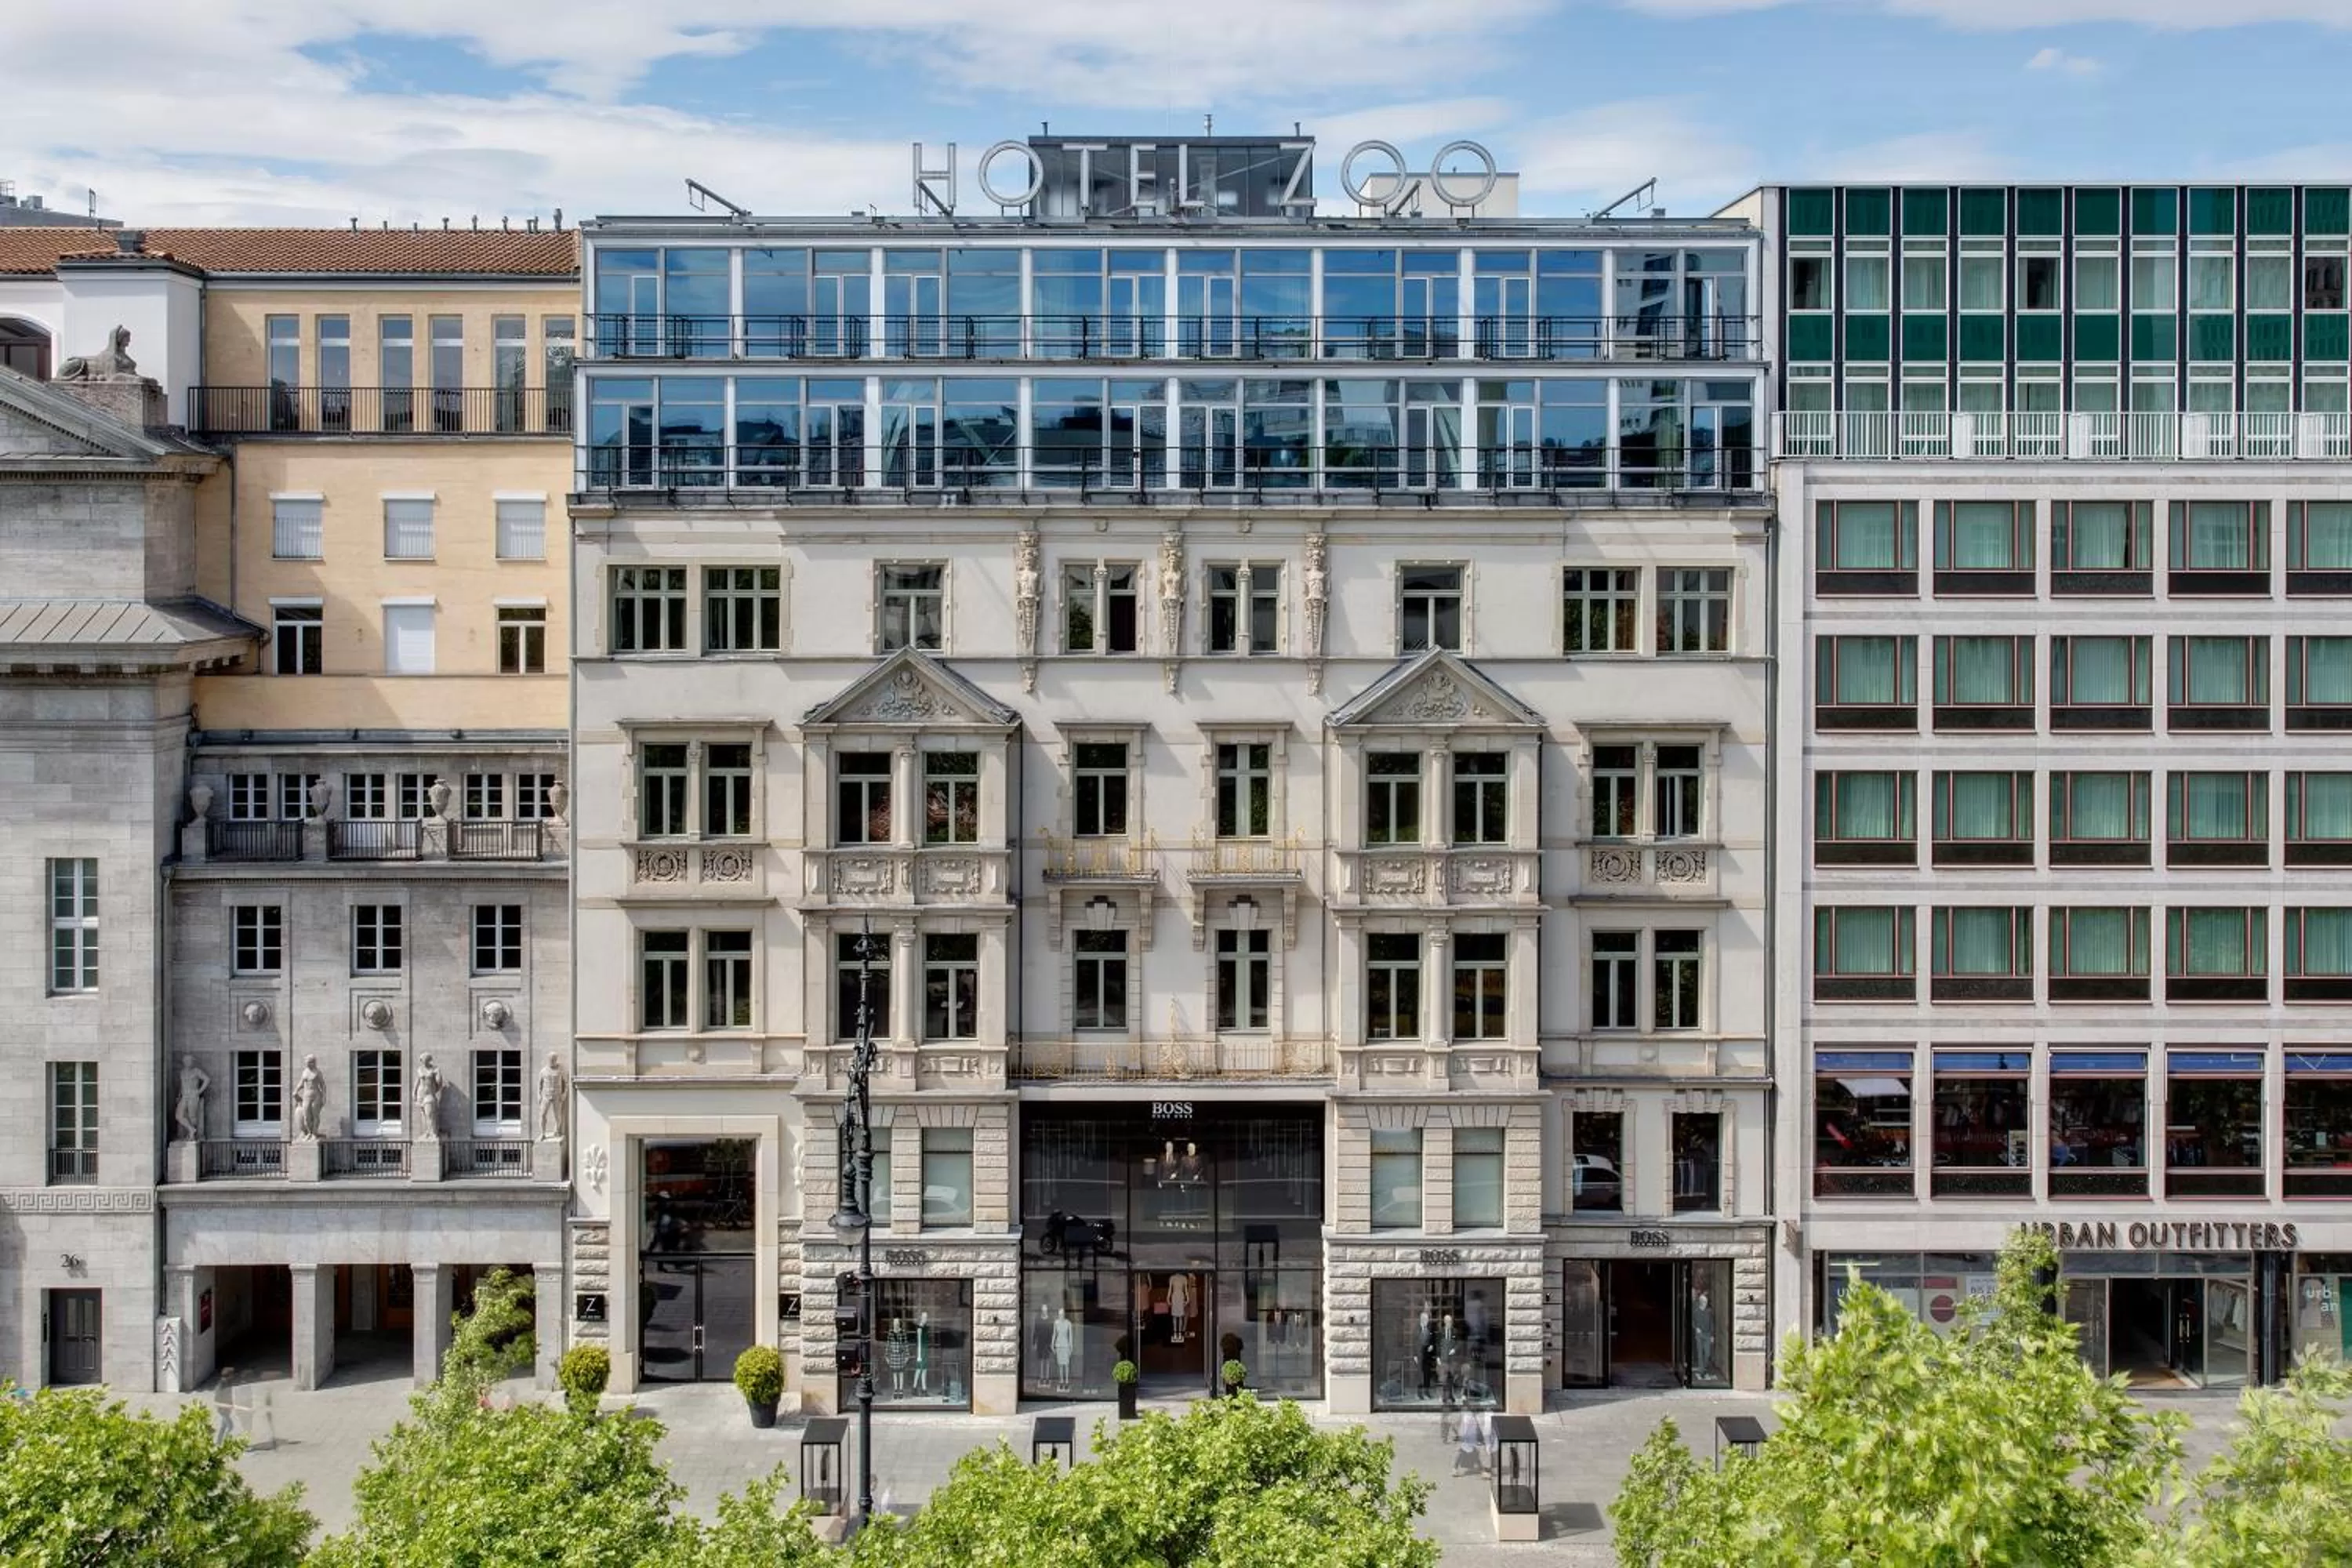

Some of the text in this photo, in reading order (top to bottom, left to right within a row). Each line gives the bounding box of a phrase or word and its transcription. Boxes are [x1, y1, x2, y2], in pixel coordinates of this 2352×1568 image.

[913, 140, 1497, 208] HOTEL ZOO
[1152, 1102, 1192, 1114] BOSS
[2129, 1222, 2297, 1248] OUTFITTERS
